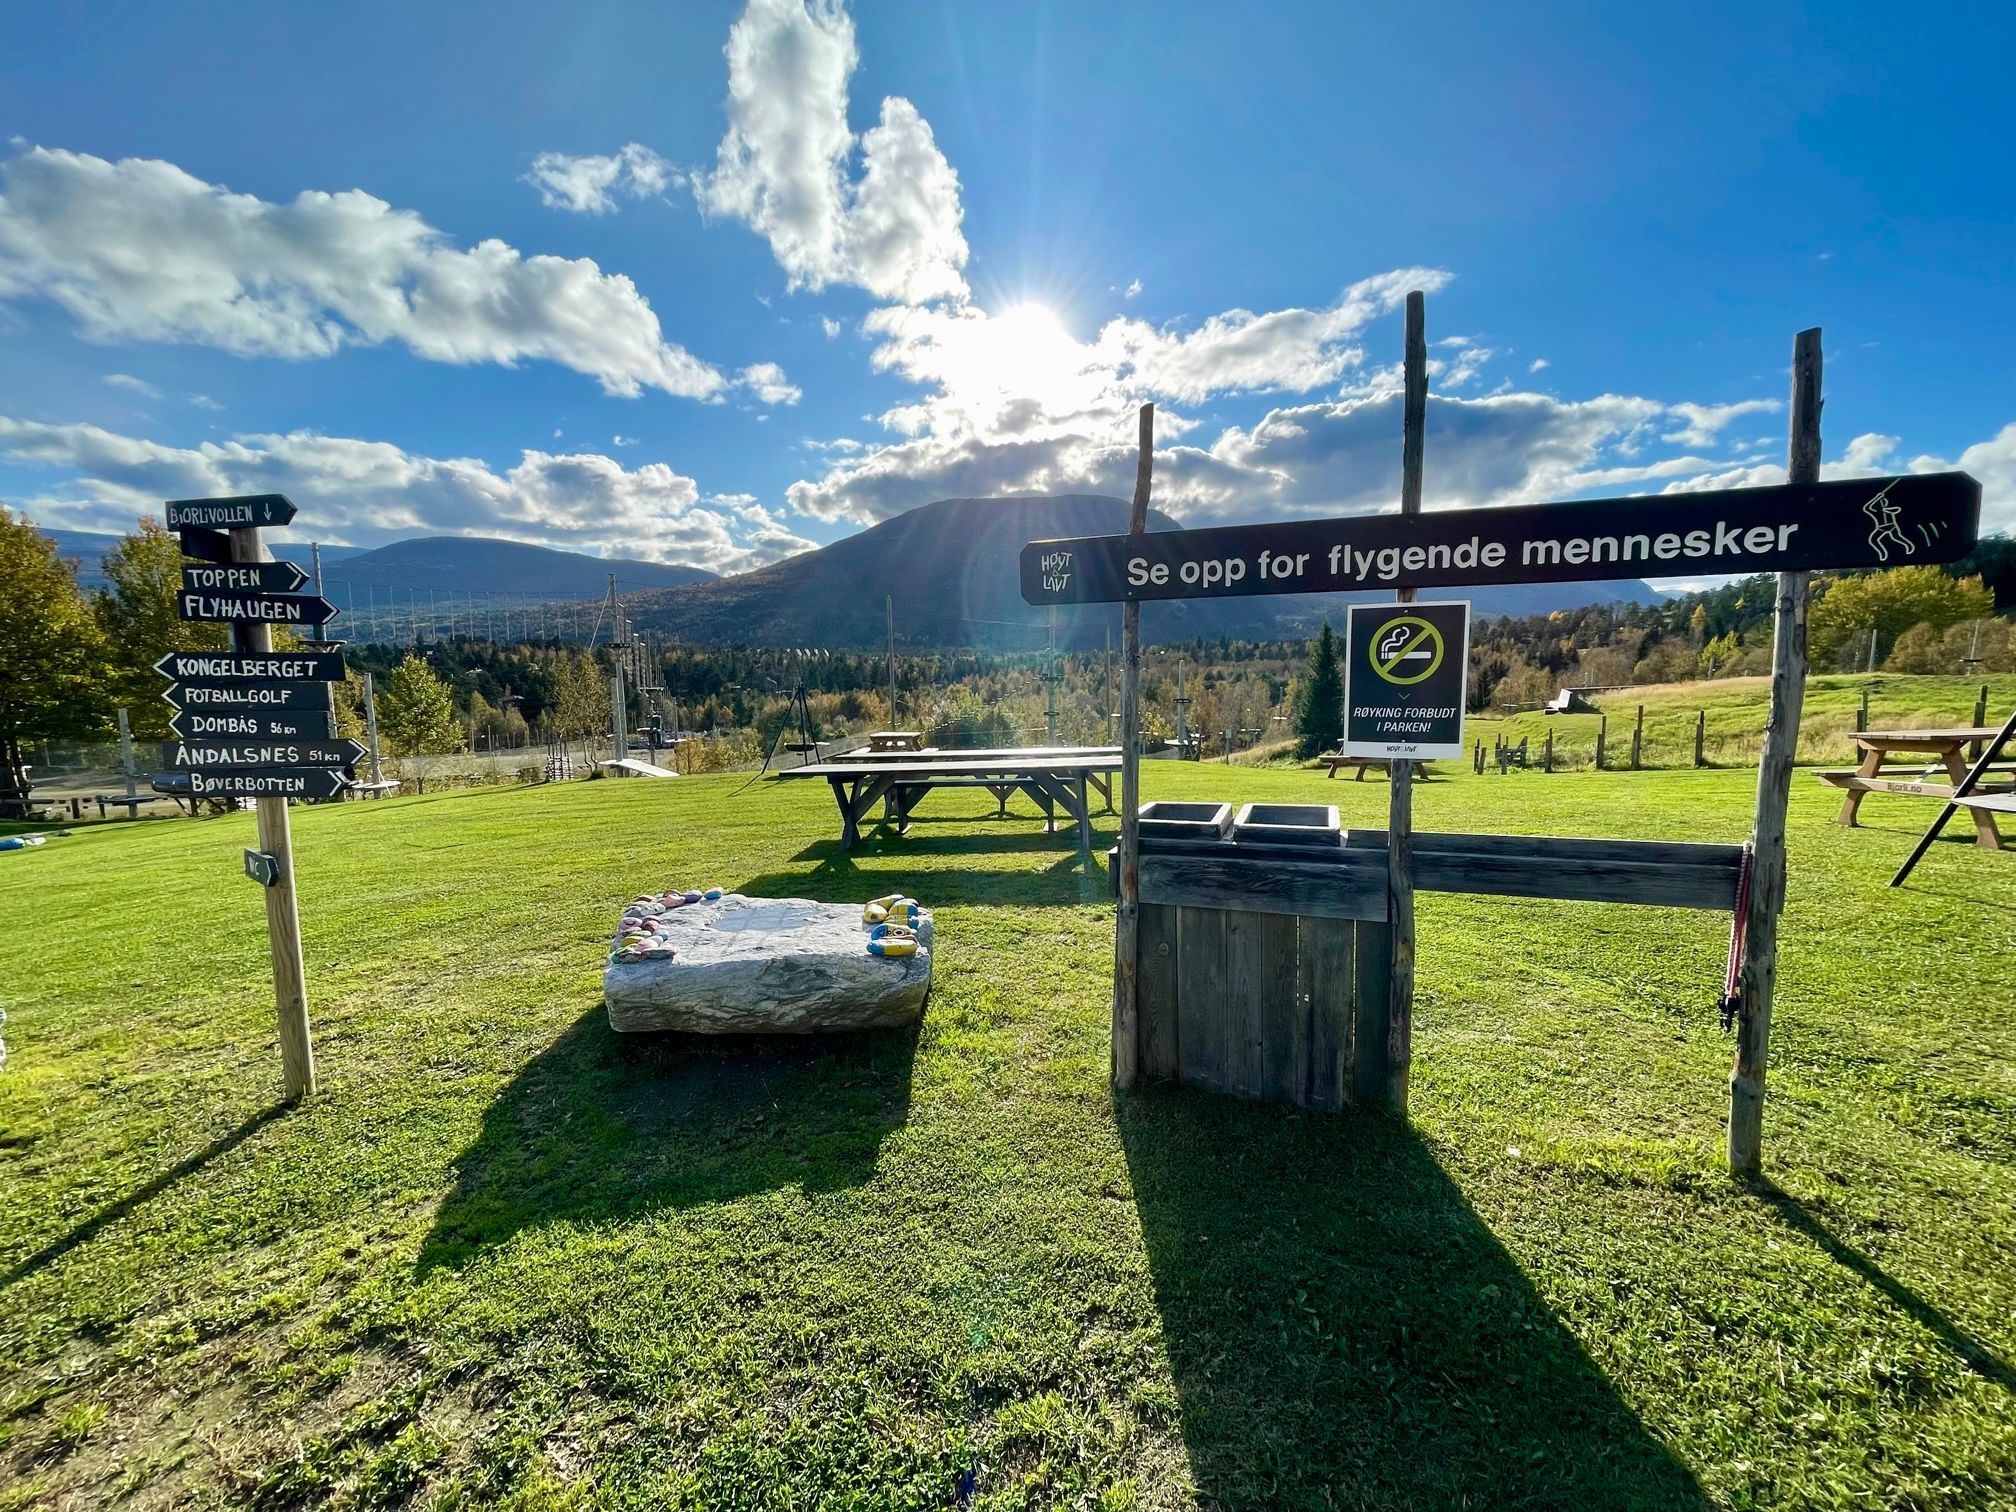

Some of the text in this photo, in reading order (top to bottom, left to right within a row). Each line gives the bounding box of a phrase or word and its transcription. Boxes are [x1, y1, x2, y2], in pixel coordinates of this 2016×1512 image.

[1127, 521, 1799, 588] Se opp for flygende mennesker
[187, 569, 260, 588] TOPPEN
[1052, 565, 1061, 577] &
[1043, 574, 1071, 592] LAVT
[185, 595, 300, 619] FLYHAUGEN
[176, 658, 318, 677] KONGELBERGET
[185, 688, 292, 704] FOTBALLGOLF
[1354, 707, 1456, 718] RØYKING FORBUDT
[191, 715, 258, 734] DOMBÅS
[270, 722, 282, 734] 56
[1376, 722, 1431, 732] I PARKEN!
[175, 741, 299, 765] ÅNDALSNES
[309, 750, 322, 761] 51
